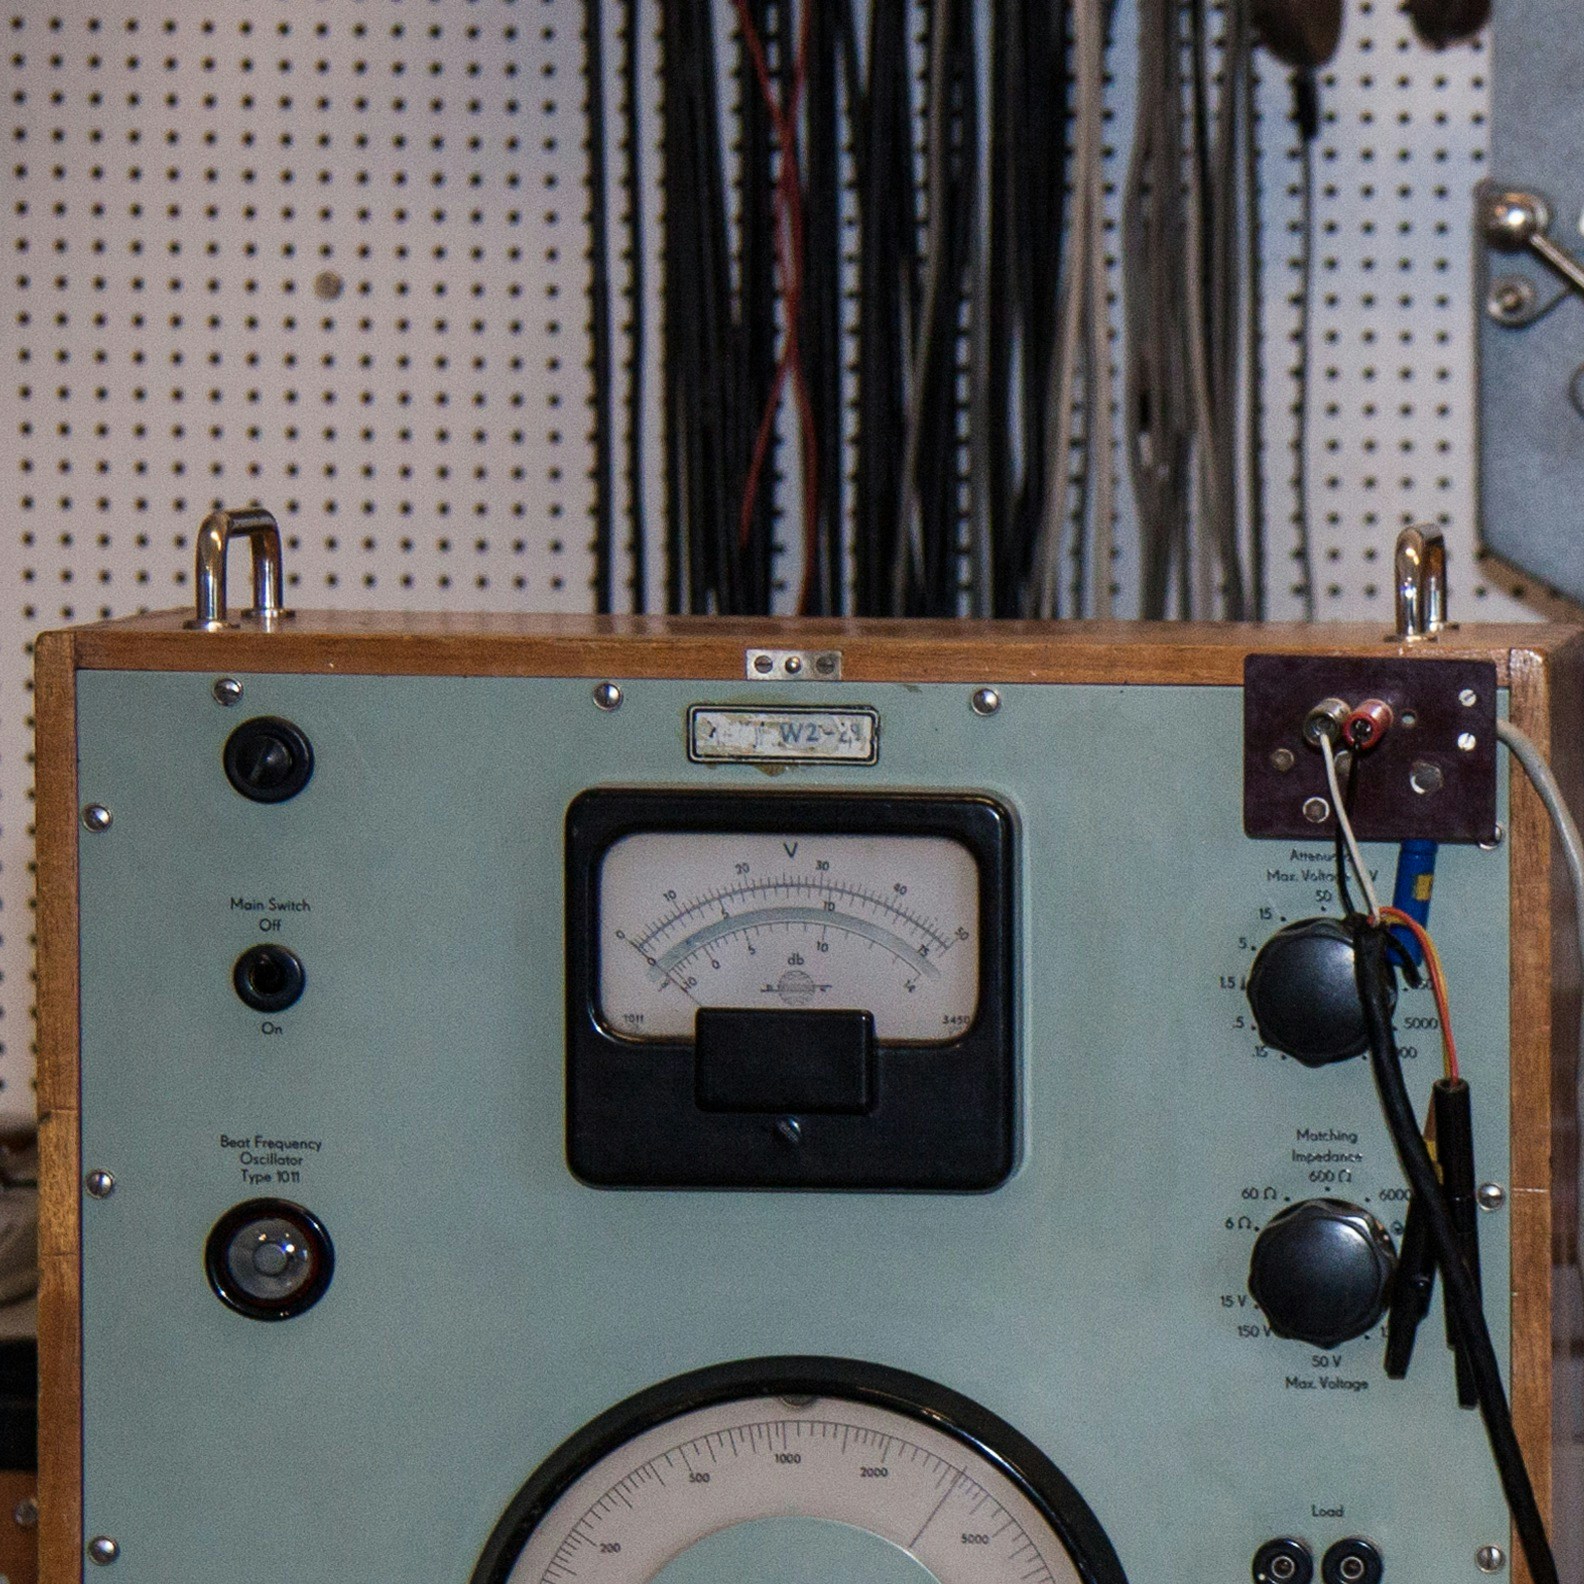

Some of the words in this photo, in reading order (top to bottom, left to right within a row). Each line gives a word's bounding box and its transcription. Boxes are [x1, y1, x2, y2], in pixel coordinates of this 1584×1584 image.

[783, 842, 798, 858] V
[615, 929, 626, 940] 0
[663, 889, 678, 902] 10
[735, 862, 750, 875] 20
[815, 860, 830, 871] 30
[954, 926, 970, 942] 50
[1315, 889, 1332, 902] 50
[230, 897, 264, 911] Main
[268, 896, 311, 912] Switch
[1259, 907, 1272, 920] 15
[259, 917, 282, 932] Off
[1238, 937, 1247, 950] 5
[711, 960, 721, 970] 0
[816, 940, 829, 953] 10
[787, 953, 804, 966] db
[261, 1021, 283, 1035] On
[1403, 1016, 1439, 1030] 5000
[220, 1134, 251, 1149] Beat
[254, 1135, 322, 1152] Frequency
[1296, 1128, 1359, 1145] Matching
[240, 1151, 304, 1166] Oscillator
[1292, 1150, 1363, 1165] Impedance
[240, 1168, 272, 1185] Type
[276, 1170, 300, 1184] 1011
[1308, 1170, 1335, 1183] 600
[1241, 1187, 1260, 1200] 60
[1224, 1216, 1235, 1230] 6
[1220, 1295, 1233, 1308] 15
[1236, 1294, 1247, 1307] V
[1237, 1325, 1260, 1338] 150
[1311, 1355, 1330, 1368] 50
[1331, 1355, 1342, 1368] V
[1285, 1377, 1317, 1390] Max.
[1319, 1376, 1369, 1392] Voltage
[774, 1453, 801, 1465] 1000
[860, 1466, 888, 1478] 2000
[688, 1472, 711, 1484] 500
[961, 1533, 990, 1546] 5000
[1311, 1504, 1345, 1518] Load
[600, 1542, 622, 1554] 200
